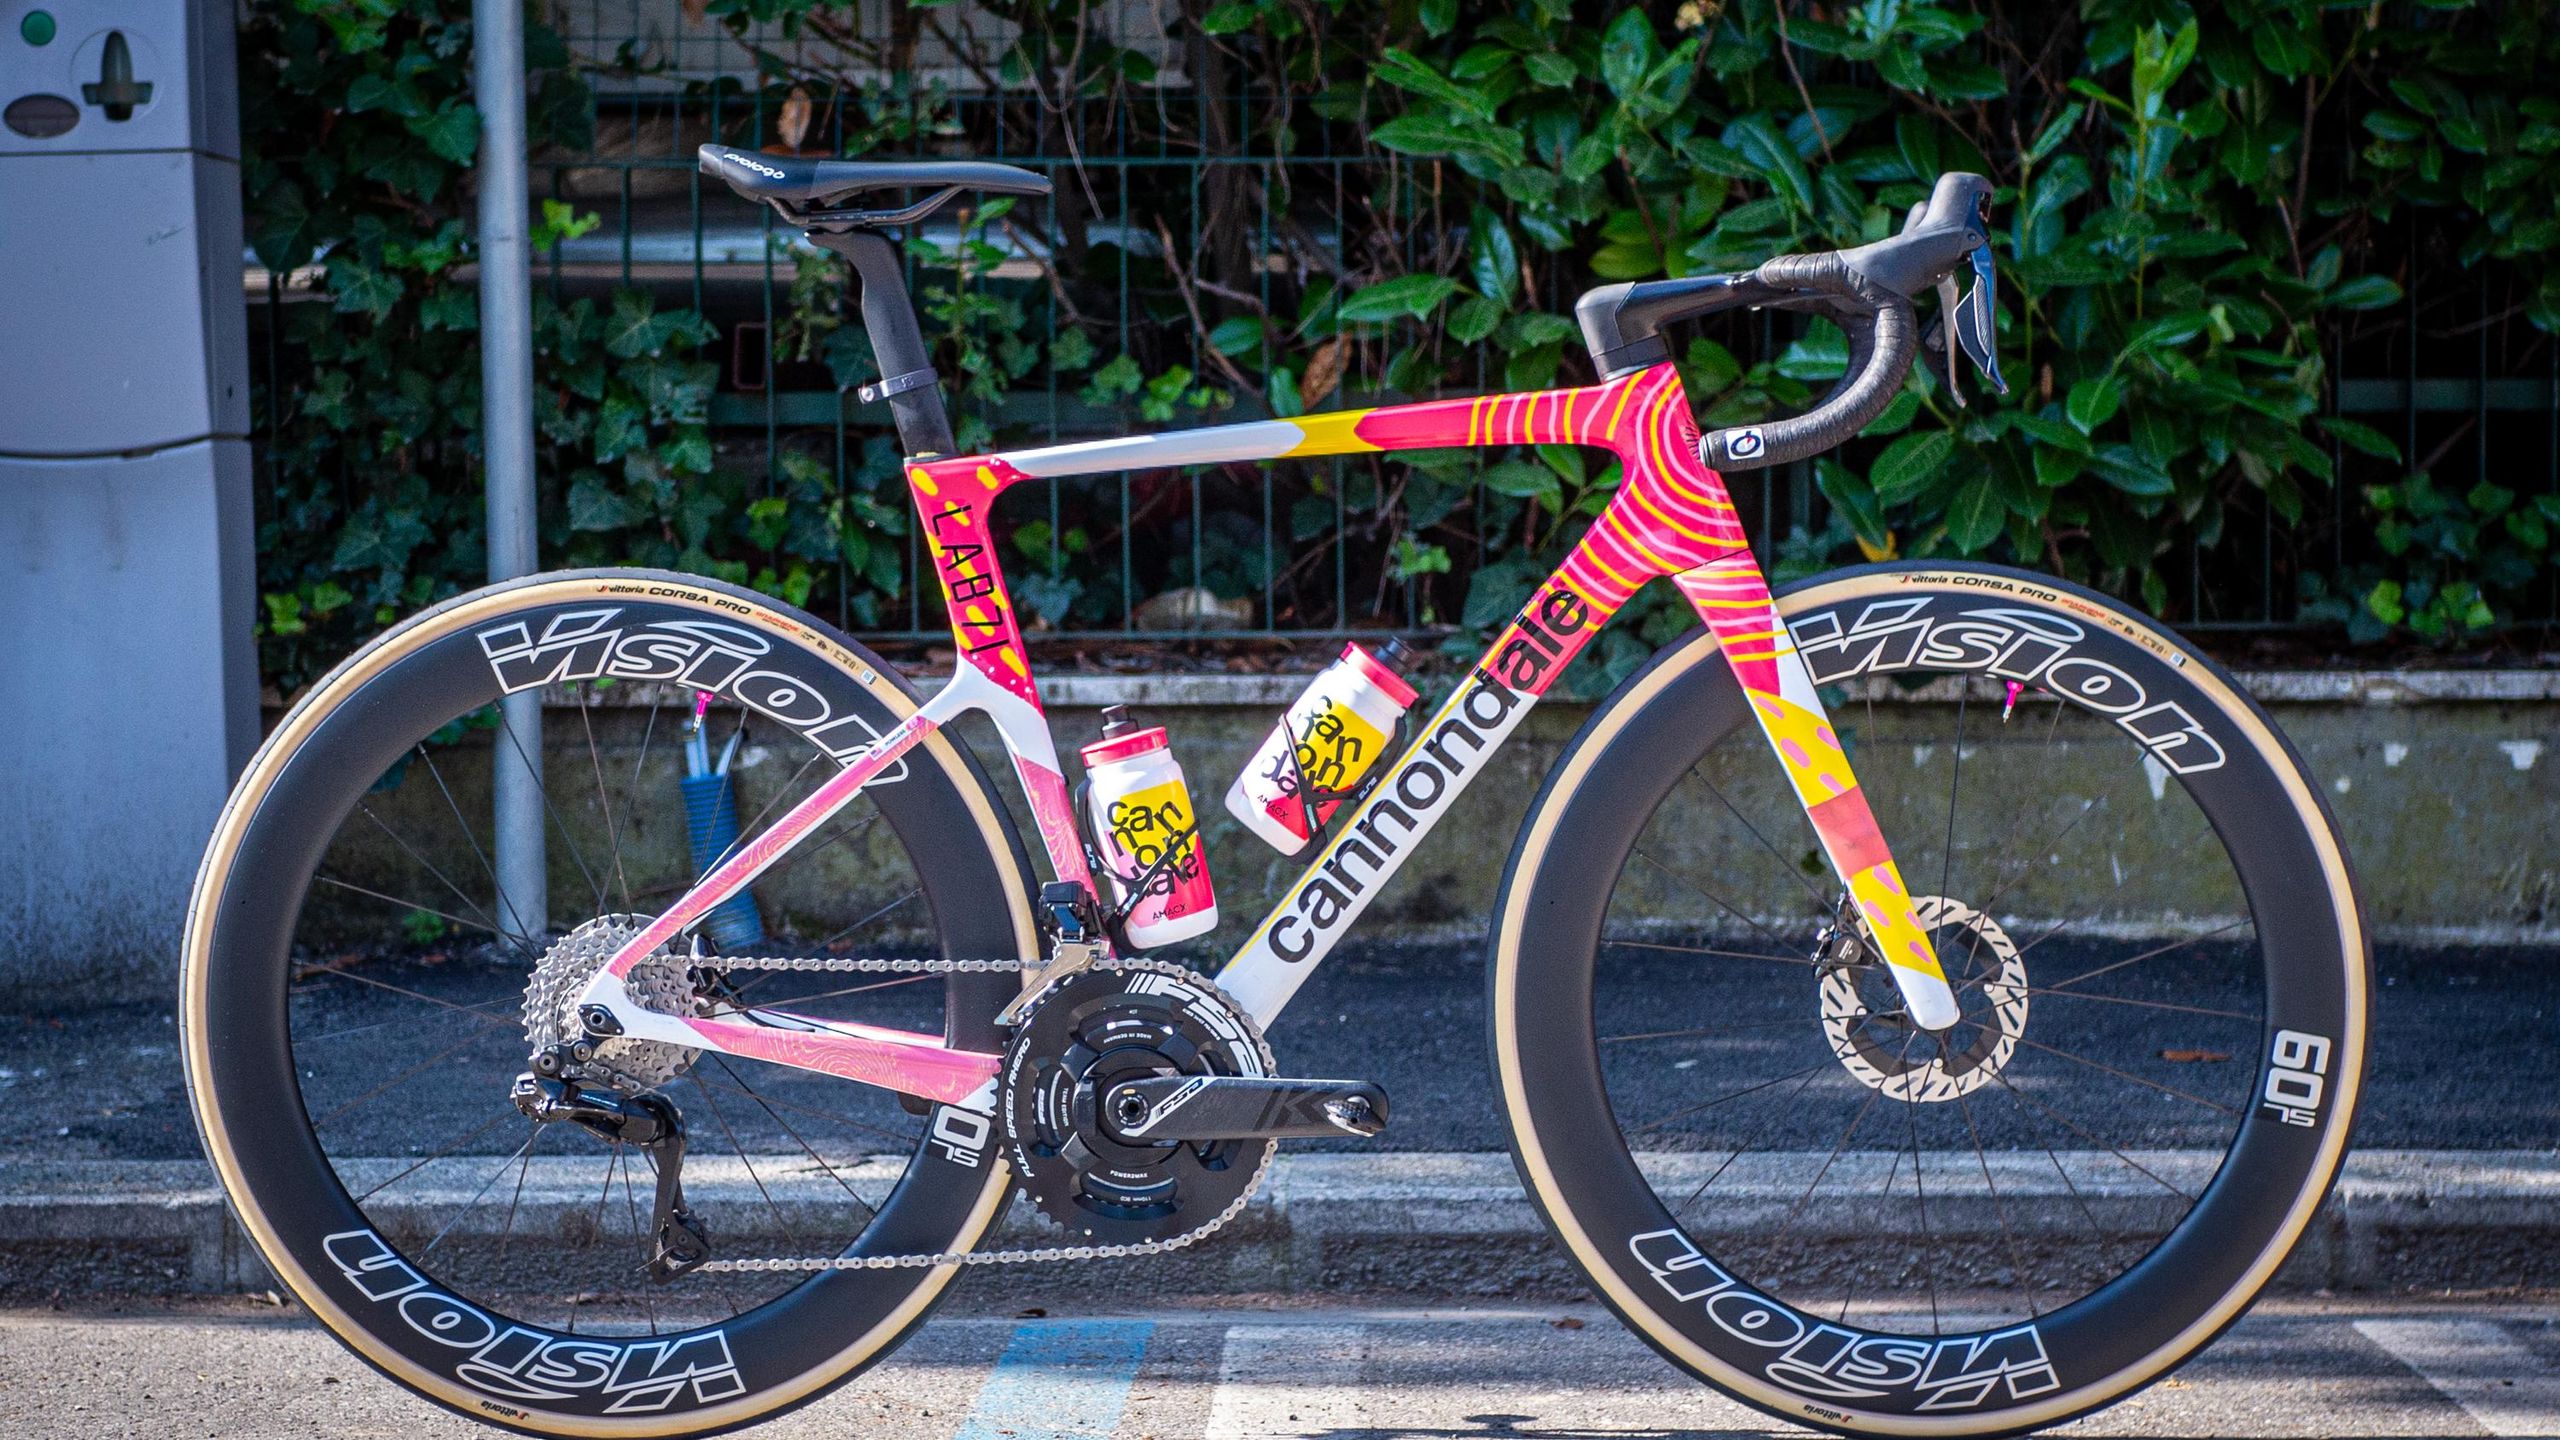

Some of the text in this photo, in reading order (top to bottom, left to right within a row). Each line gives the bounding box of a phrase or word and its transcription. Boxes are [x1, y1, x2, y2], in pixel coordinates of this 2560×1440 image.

[723, 152, 785, 180] prologo
[932, 504, 1010, 654] LAB71
[1910, 574, 2057, 602] vittoria CORSA PRO
[607, 584, 751, 615] vittoria CORSA PRO
[1268, 589, 1588, 963] cannondale
[1107, 801, 1183, 837] can
[1152, 903, 1187, 921] AMACX
[2265, 1029, 2331, 1110] 60
[1006, 1037, 1034, 1178] FULL SPEED AHEAD
[933, 1105, 991, 1151] 0
[481, 1400, 519, 1418] vittoria
[1803, 1405, 1843, 1419] vittoria
